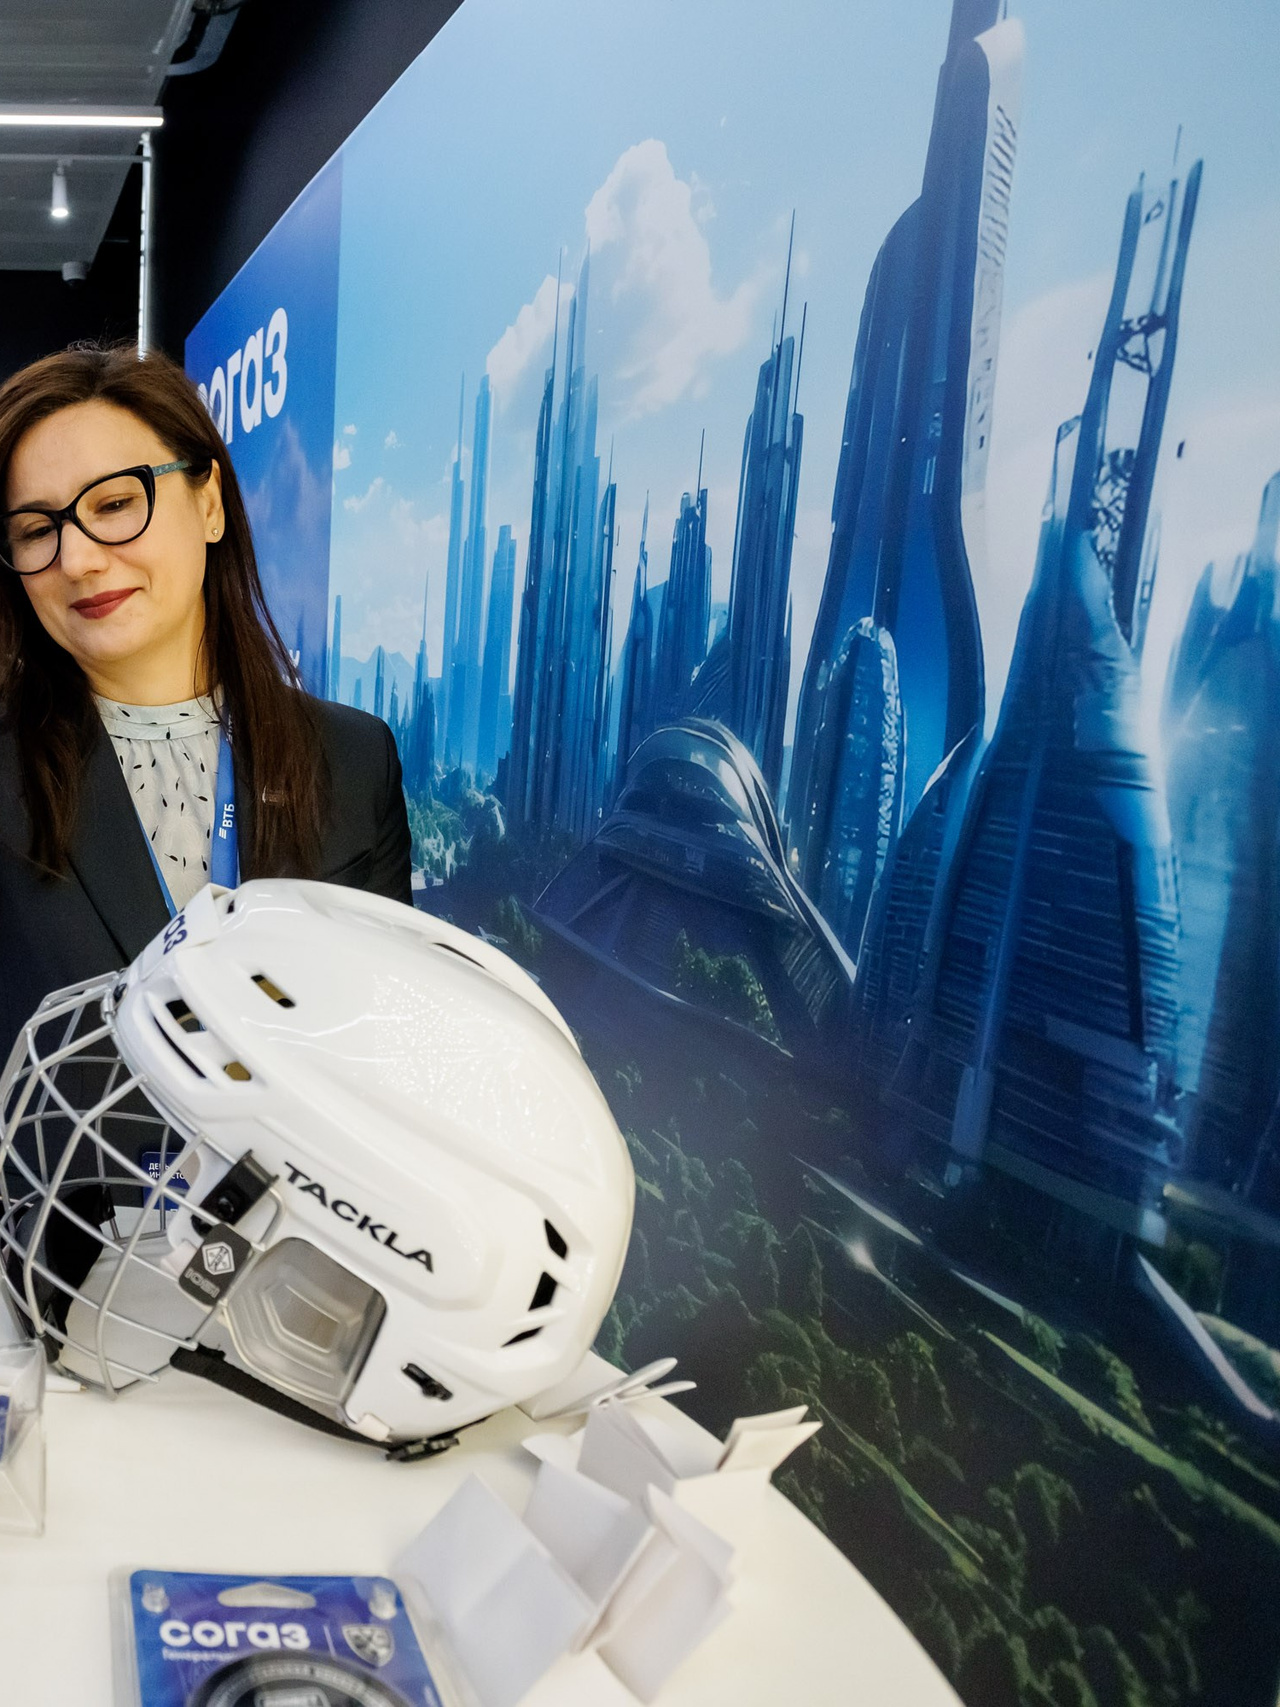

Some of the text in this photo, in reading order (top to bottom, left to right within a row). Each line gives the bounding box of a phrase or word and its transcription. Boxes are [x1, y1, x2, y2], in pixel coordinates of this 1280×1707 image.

[221, 803, 235, 829] ВТБ
[148, 1162, 171, 1171] ДЕЬ
[284, 1161, 434, 1275] TACKLA
[159, 1620, 311, 1650] согаз
